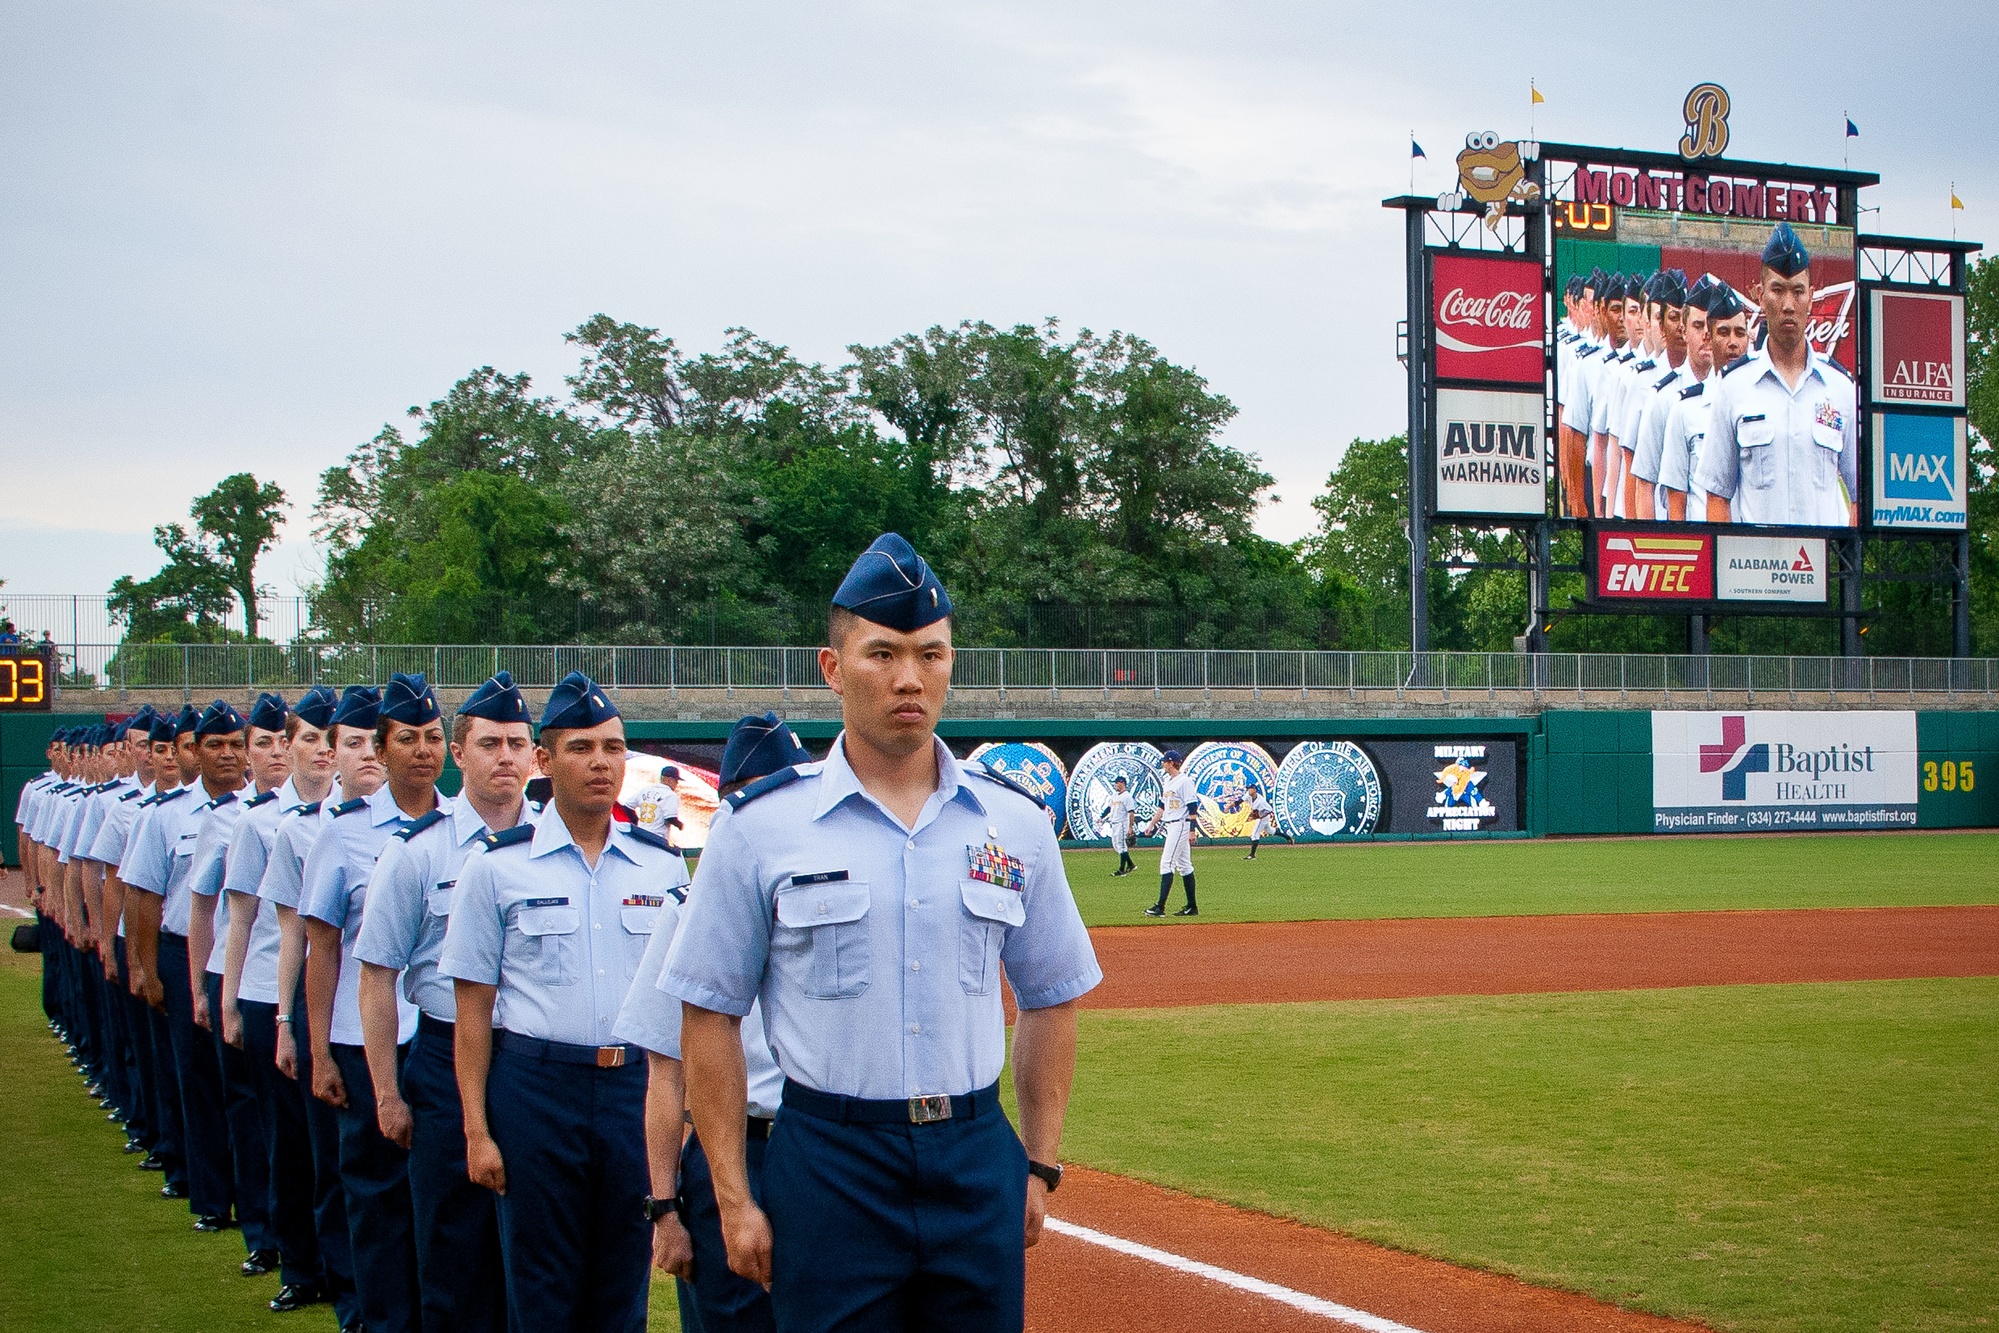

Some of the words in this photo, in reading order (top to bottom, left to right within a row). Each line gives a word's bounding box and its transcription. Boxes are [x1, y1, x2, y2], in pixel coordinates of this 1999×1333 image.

[1679, 83, 1730, 160] B
[1574, 167, 1832, 224] MONTGOMERY
[1440, 288, 1537, 329] Coca-Cola
[1892, 360, 1952, 387] ALFA
[1886, 388, 1951, 400] INSURANCE
[1442, 420, 1537, 462] AUM
[1441, 462, 1540, 485] WARHAWKS
[1890, 452, 1953, 492] MAX
[1873, 506, 1965, 524] myMAX.com
[1729, 558, 1789, 571] ALABAMA
[1606, 564, 1696, 592] ENTEC
[1771, 573, 1815, 585] POWER
[1434, 745, 1486, 758] MILITARY
[1774, 742, 1875, 781] Baptist
[1353, 756, 1371, 776] AIR
[1923, 761, 1975, 792] 395
[1776, 782, 1847, 800] HEALTH
[1426, 806, 1496, 818] APPRECIATION
[1655, 813, 1704, 829] Physician
[1707, 812, 1738, 825] Finder
[1747, 811, 1772, 827] (334)
[1774, 811, 1816, 824] 273-4444
[1822, 809, 1917, 825] www.baptistfirst.org
[1443, 818, 1480, 830] NIGHT
